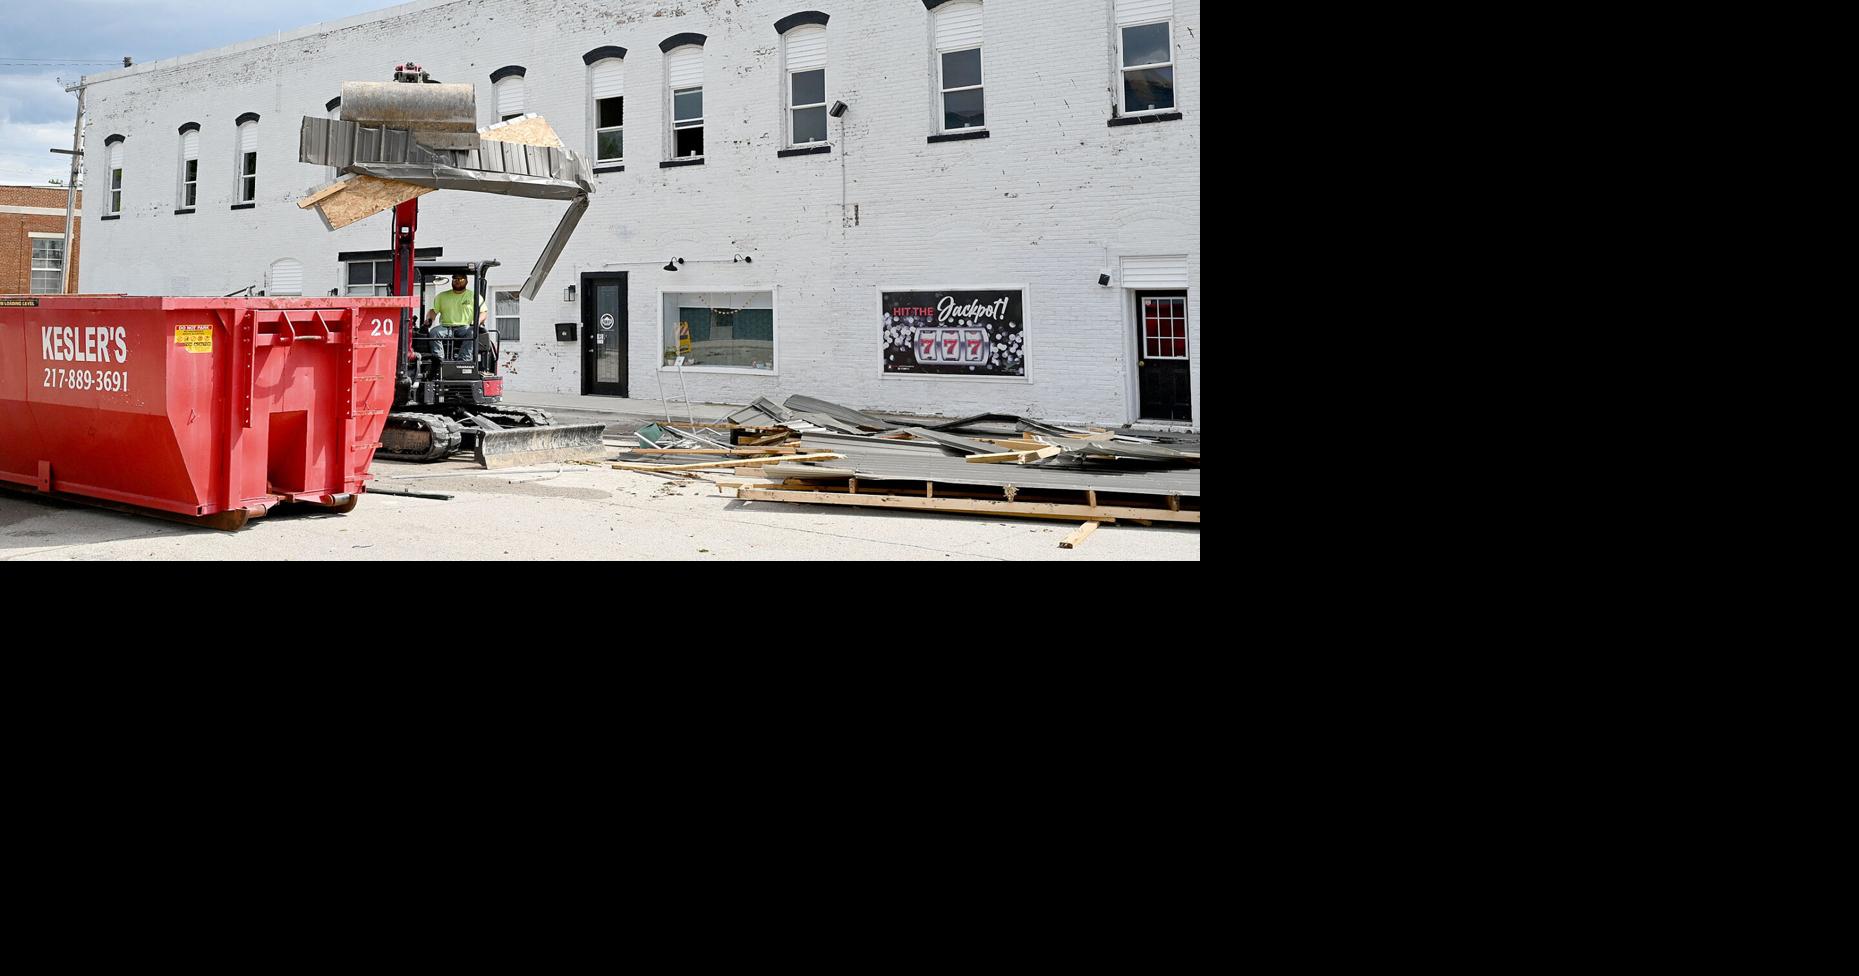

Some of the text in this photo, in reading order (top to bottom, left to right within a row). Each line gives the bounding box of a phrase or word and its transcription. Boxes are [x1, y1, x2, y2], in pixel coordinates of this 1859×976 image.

[893, 295, 1009, 323] HIT THE Jackpot!
[371, 318, 393, 336] 20
[41, 326, 127, 364] KESLER'S
[920, 339, 981, 355] 7 7 7
[43, 367, 128, 392] 217-889-3691
